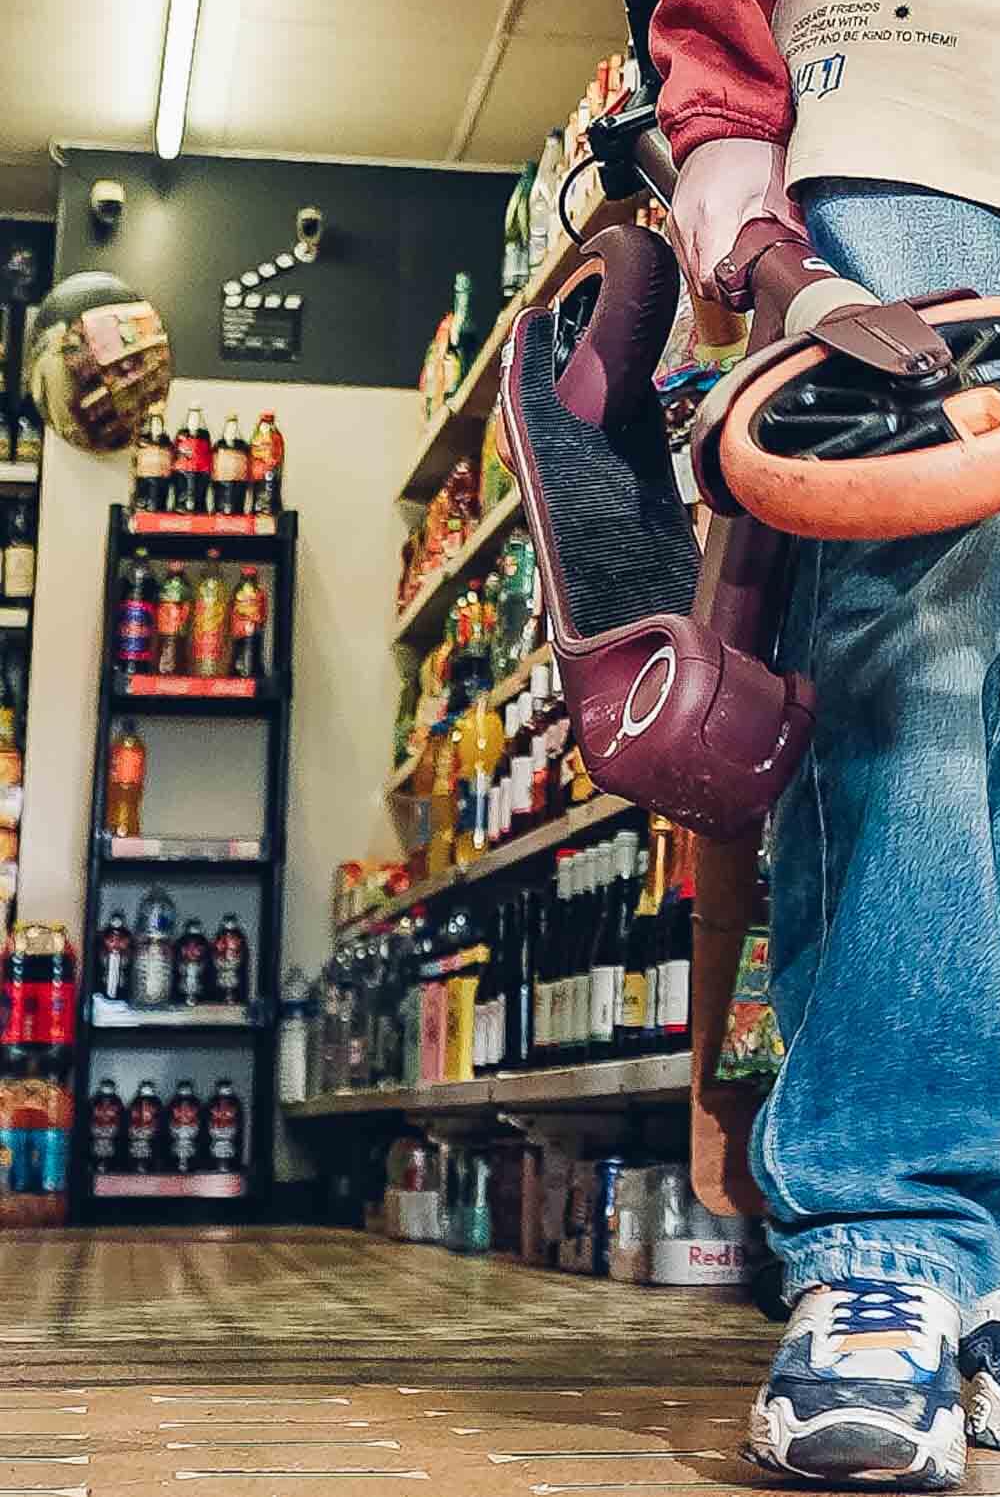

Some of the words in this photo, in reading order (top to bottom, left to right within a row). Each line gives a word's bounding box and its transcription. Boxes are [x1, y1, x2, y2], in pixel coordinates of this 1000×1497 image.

[838, 15, 869, 28] WITH
[843, 29, 858, 42] BE
[862, 30, 892, 42] KIND
[896, 30, 912, 43] TO
